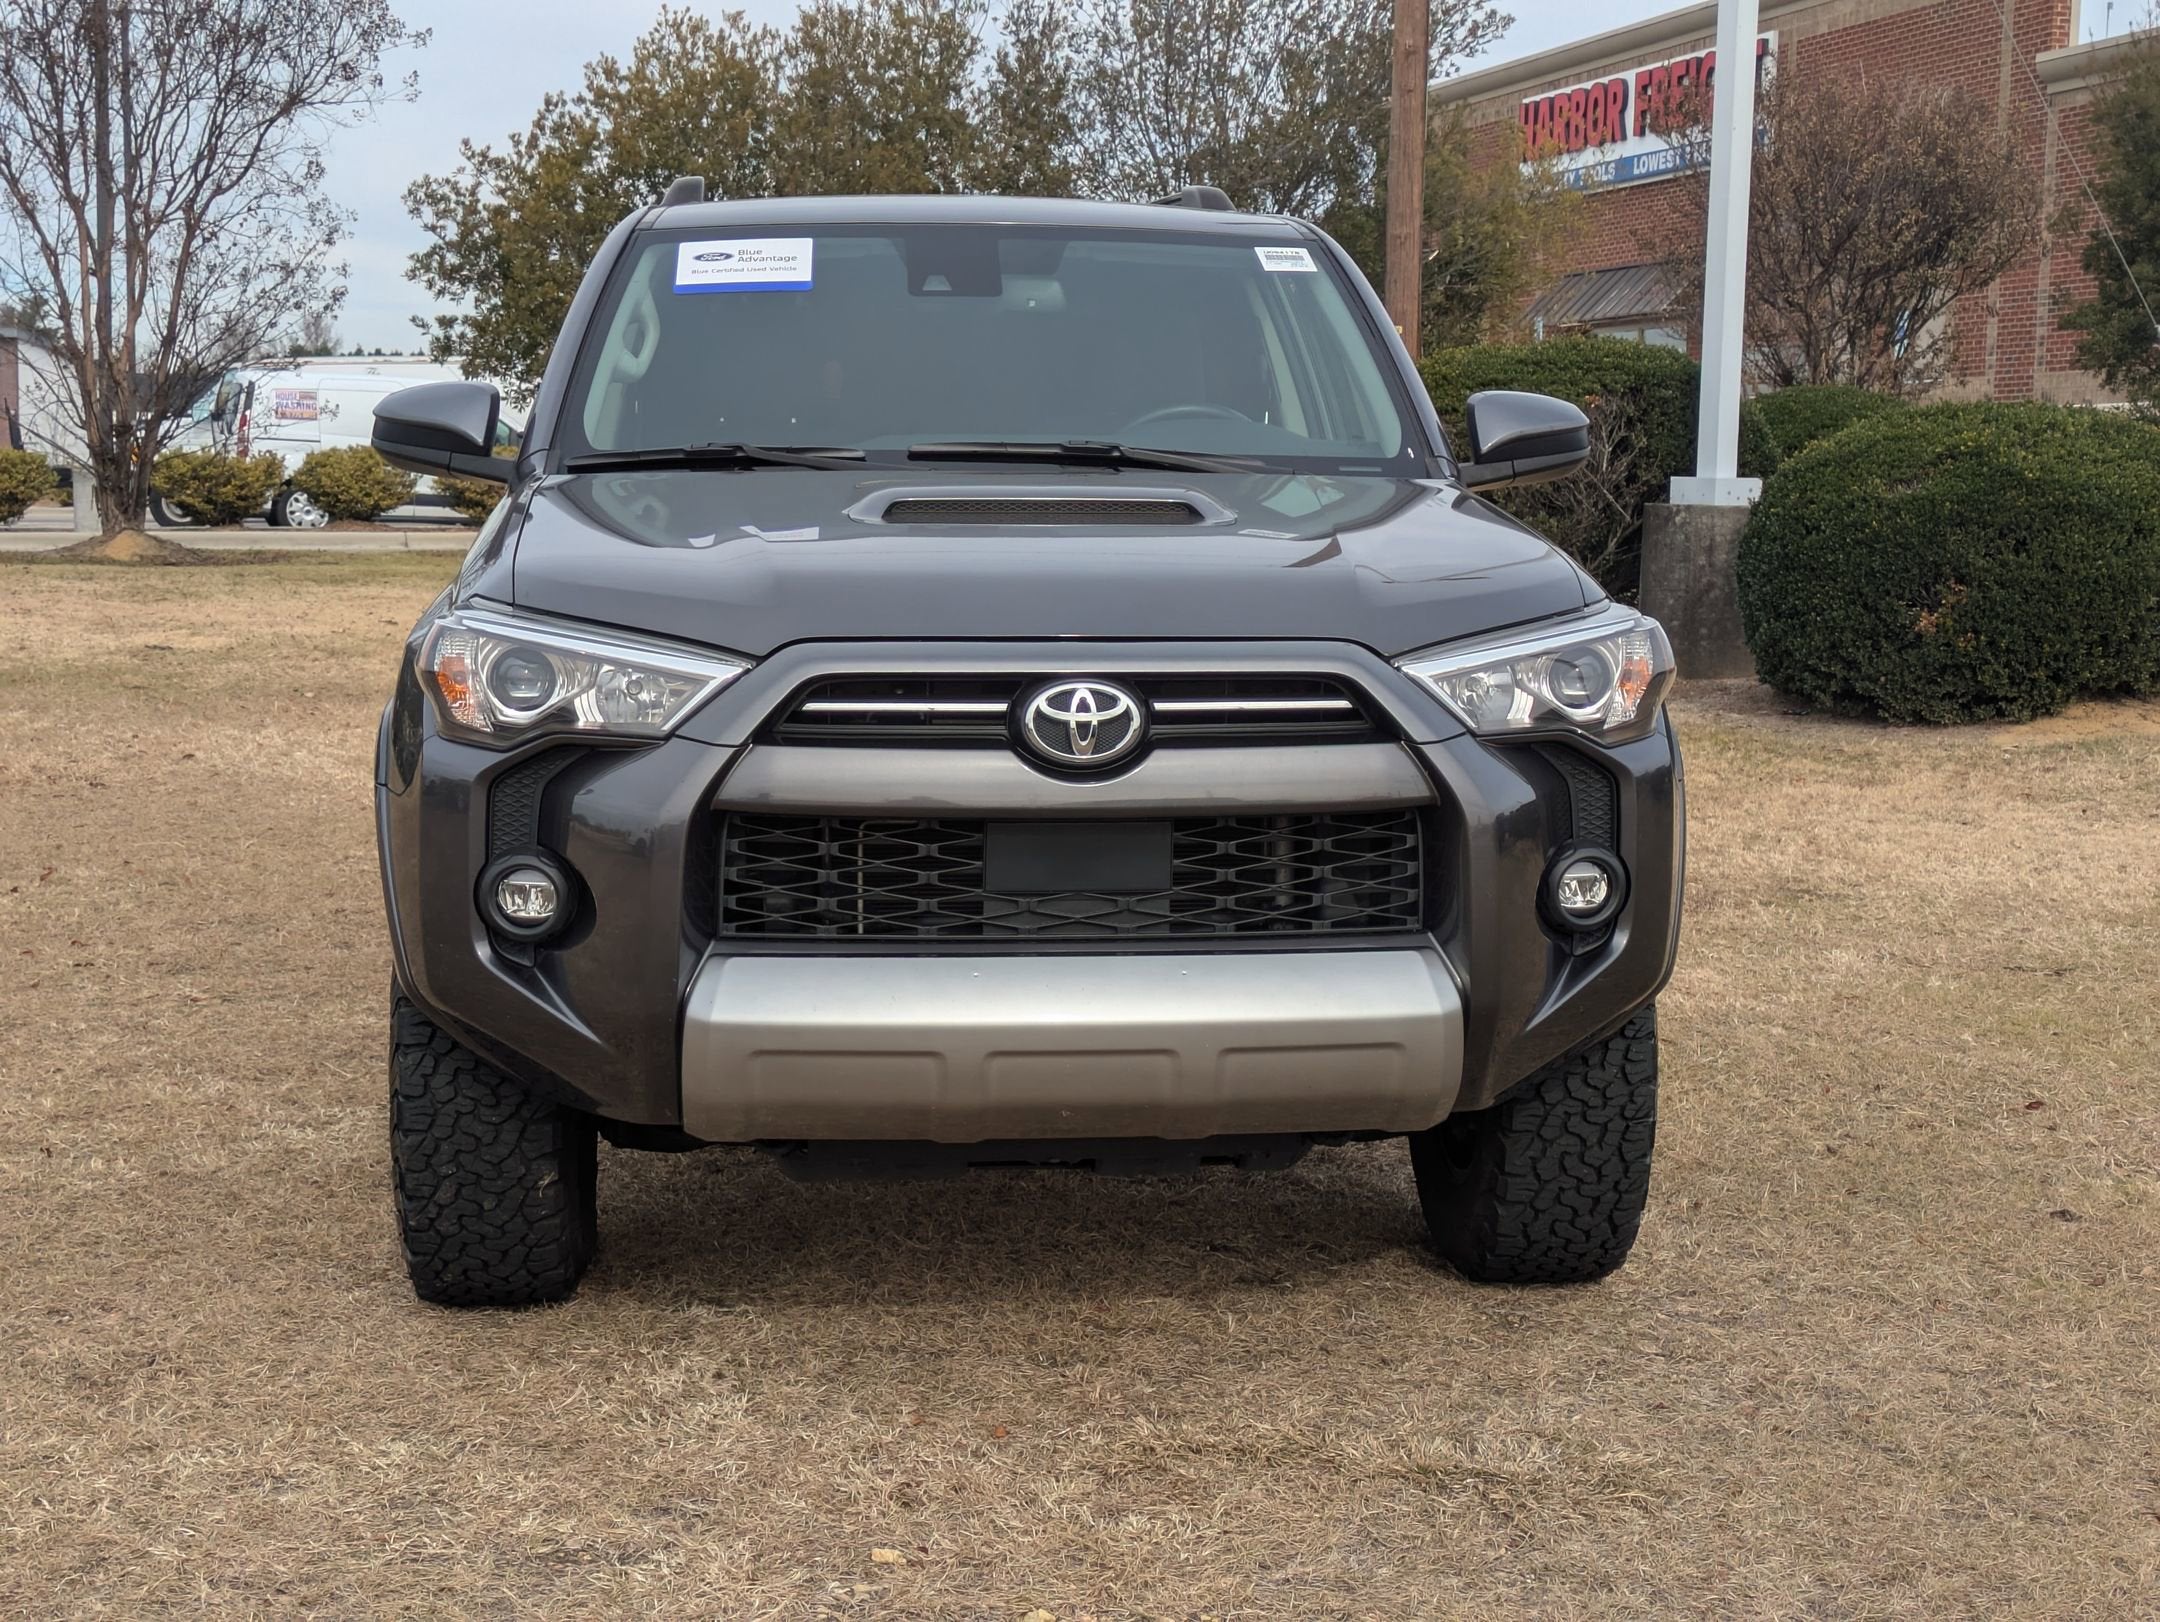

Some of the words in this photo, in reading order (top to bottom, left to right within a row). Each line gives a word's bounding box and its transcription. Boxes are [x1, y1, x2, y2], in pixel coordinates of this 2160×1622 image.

[1519, 78, 1628, 162] HARBOR
[737, 255, 798, 263] Advantage
[276, 391, 298, 400] HOUSE
[276, 401, 317, 410] WASHING
